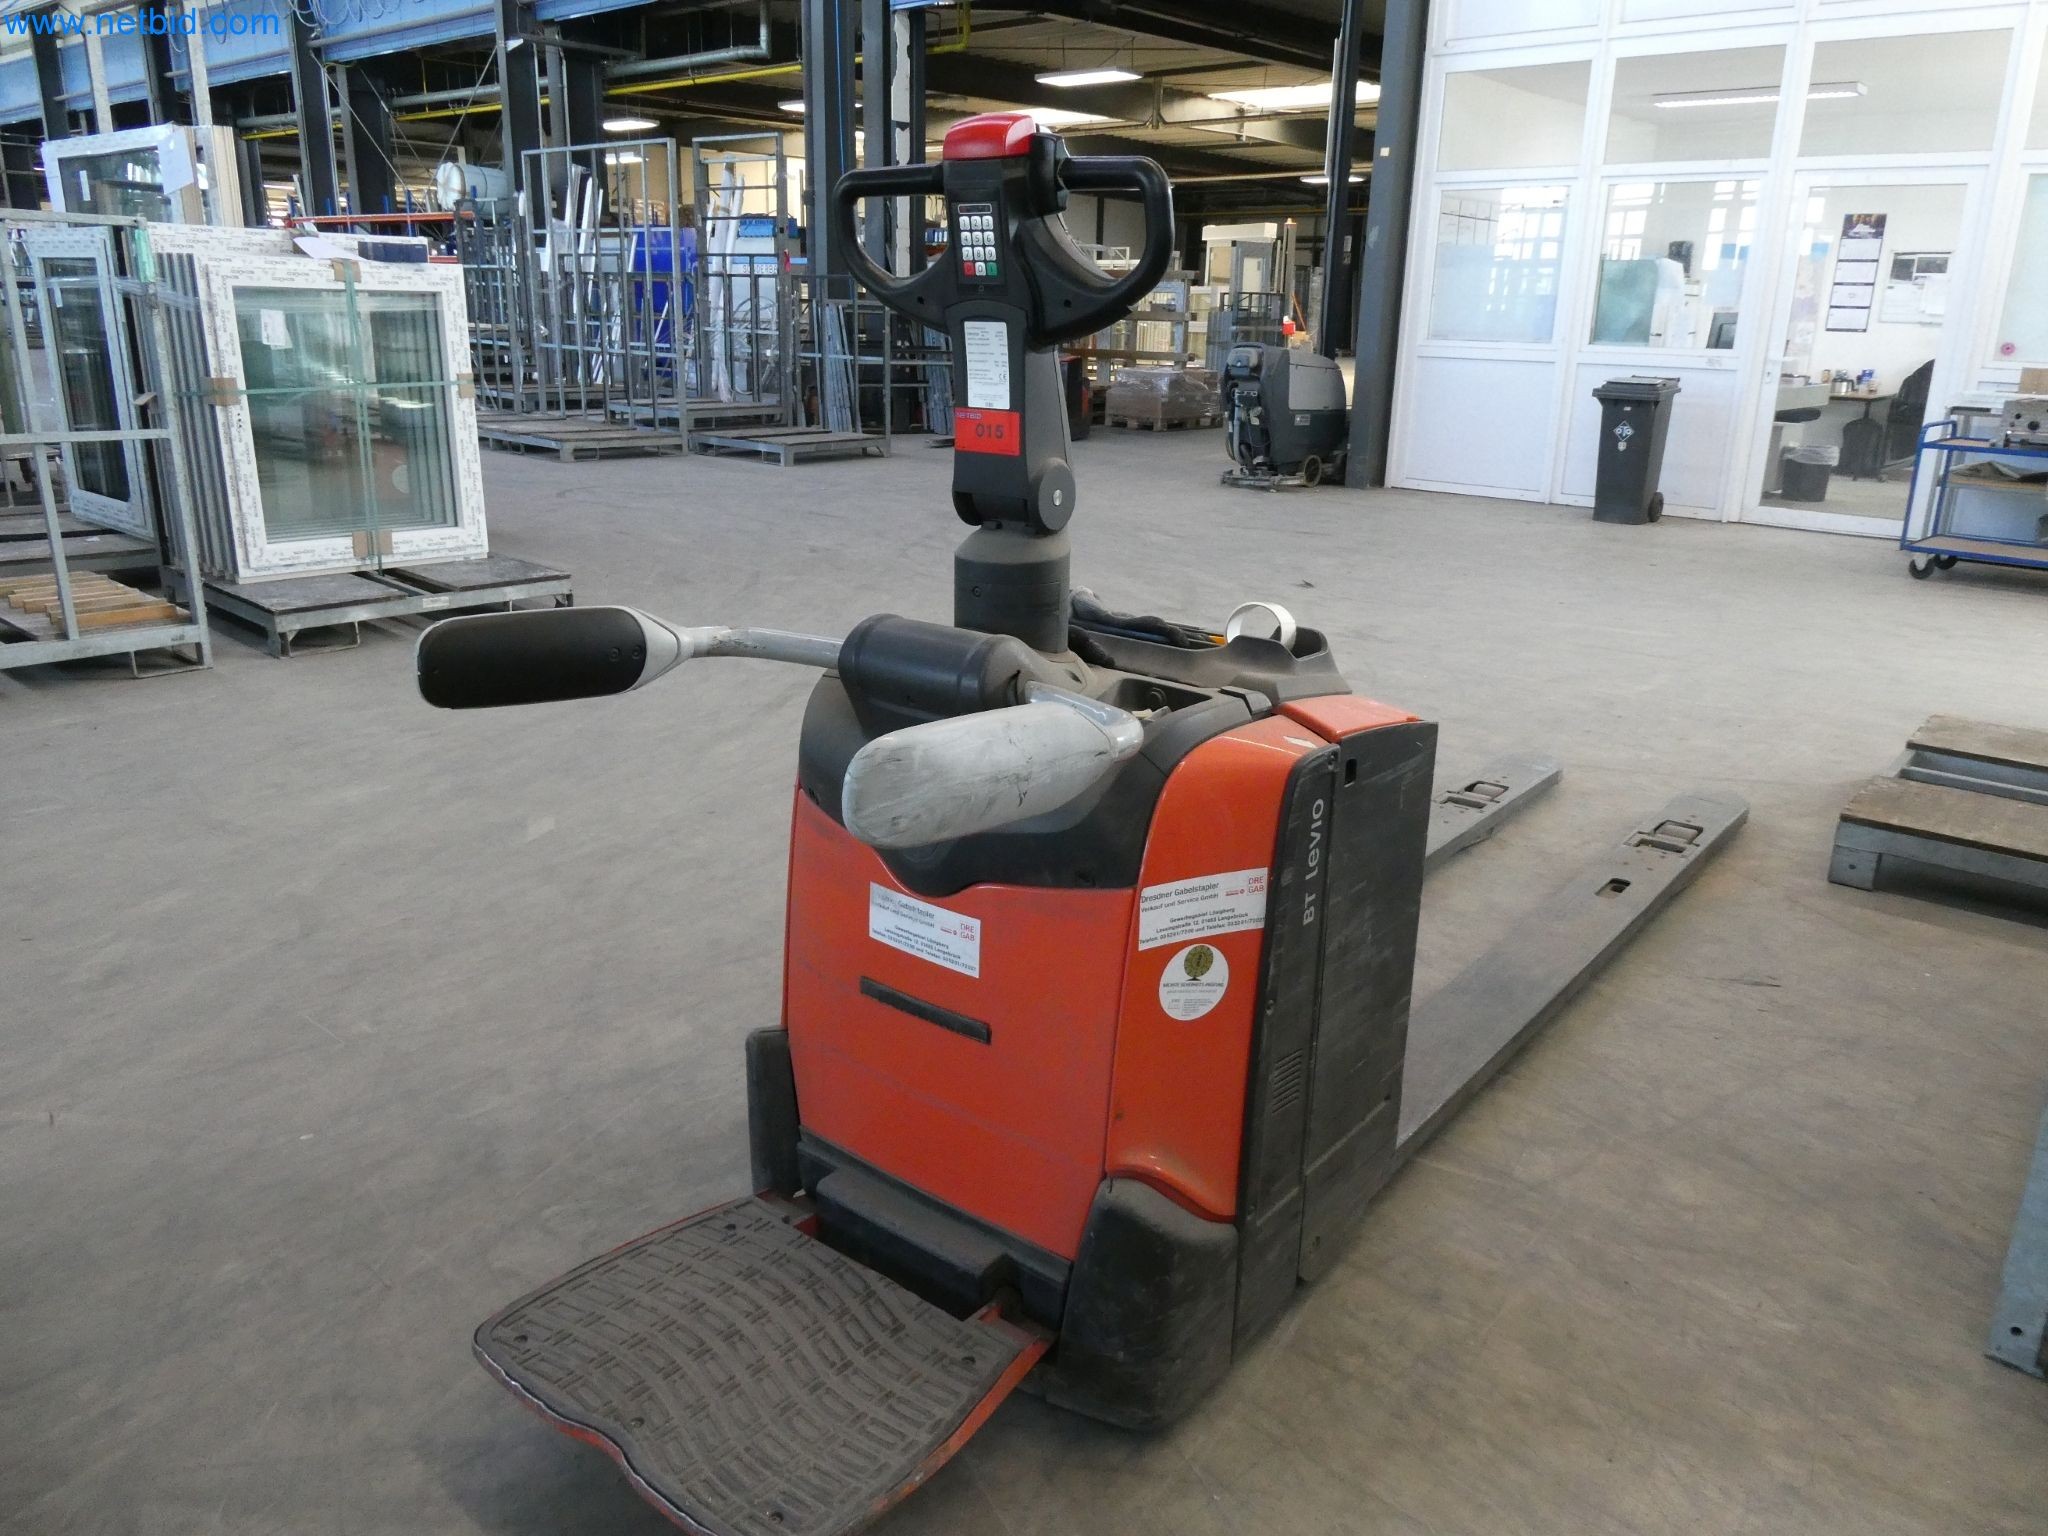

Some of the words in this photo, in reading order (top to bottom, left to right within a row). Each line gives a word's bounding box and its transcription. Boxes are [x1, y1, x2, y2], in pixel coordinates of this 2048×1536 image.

[975, 422, 1005, 440] 015
[1248, 876, 1264, 885] DRE
[1141, 891, 1173, 904] Dresdner
[1174, 882, 1219, 896] Gabelstapler
[1248, 885, 1265, 894] GAB
[1303, 892, 1317, 927] BT
[960, 922, 975, 933] DRE
[960, 932, 975, 942] GAB
